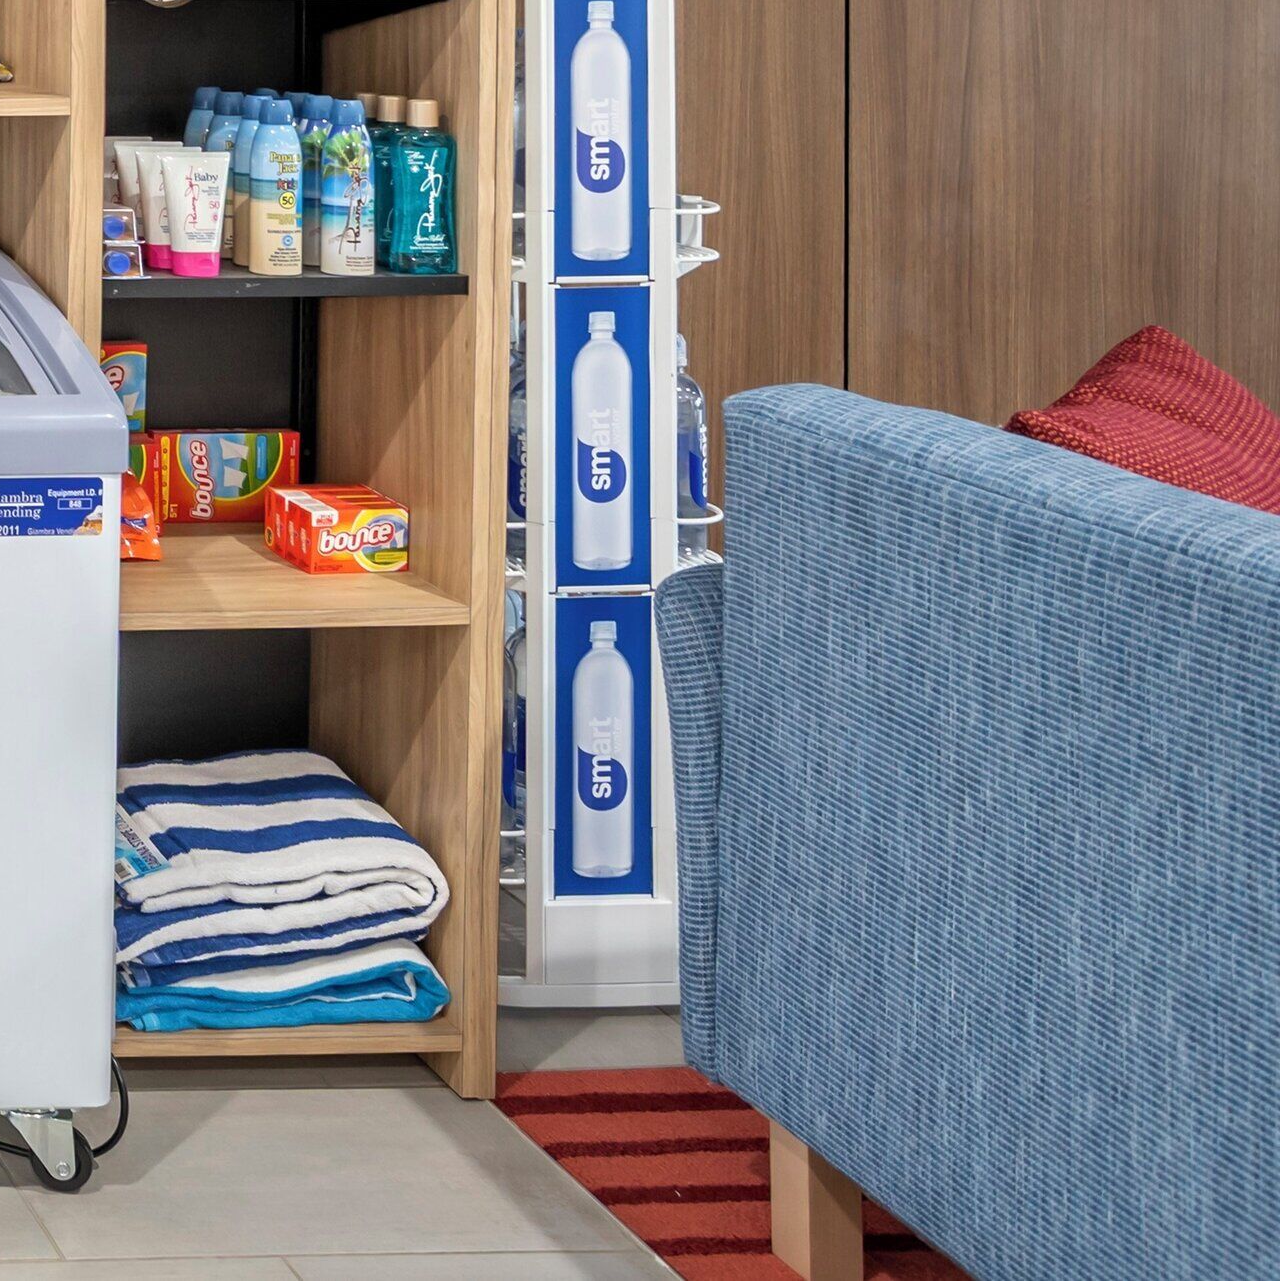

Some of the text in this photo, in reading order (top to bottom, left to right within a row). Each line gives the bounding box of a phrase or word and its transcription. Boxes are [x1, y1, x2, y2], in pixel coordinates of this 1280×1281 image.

[589, 98, 610, 181] smart
[193, 172, 219, 183] Baby
[281, 196, 295, 205] 50
[589, 408, 611, 492] smart
[47, 488, 85, 498] Equipment
[191, 439, 215, 520] bounce
[27, 527, 56, 536] Giambra
[318, 521, 394, 556] bounce
[591, 716, 612, 800] smart
